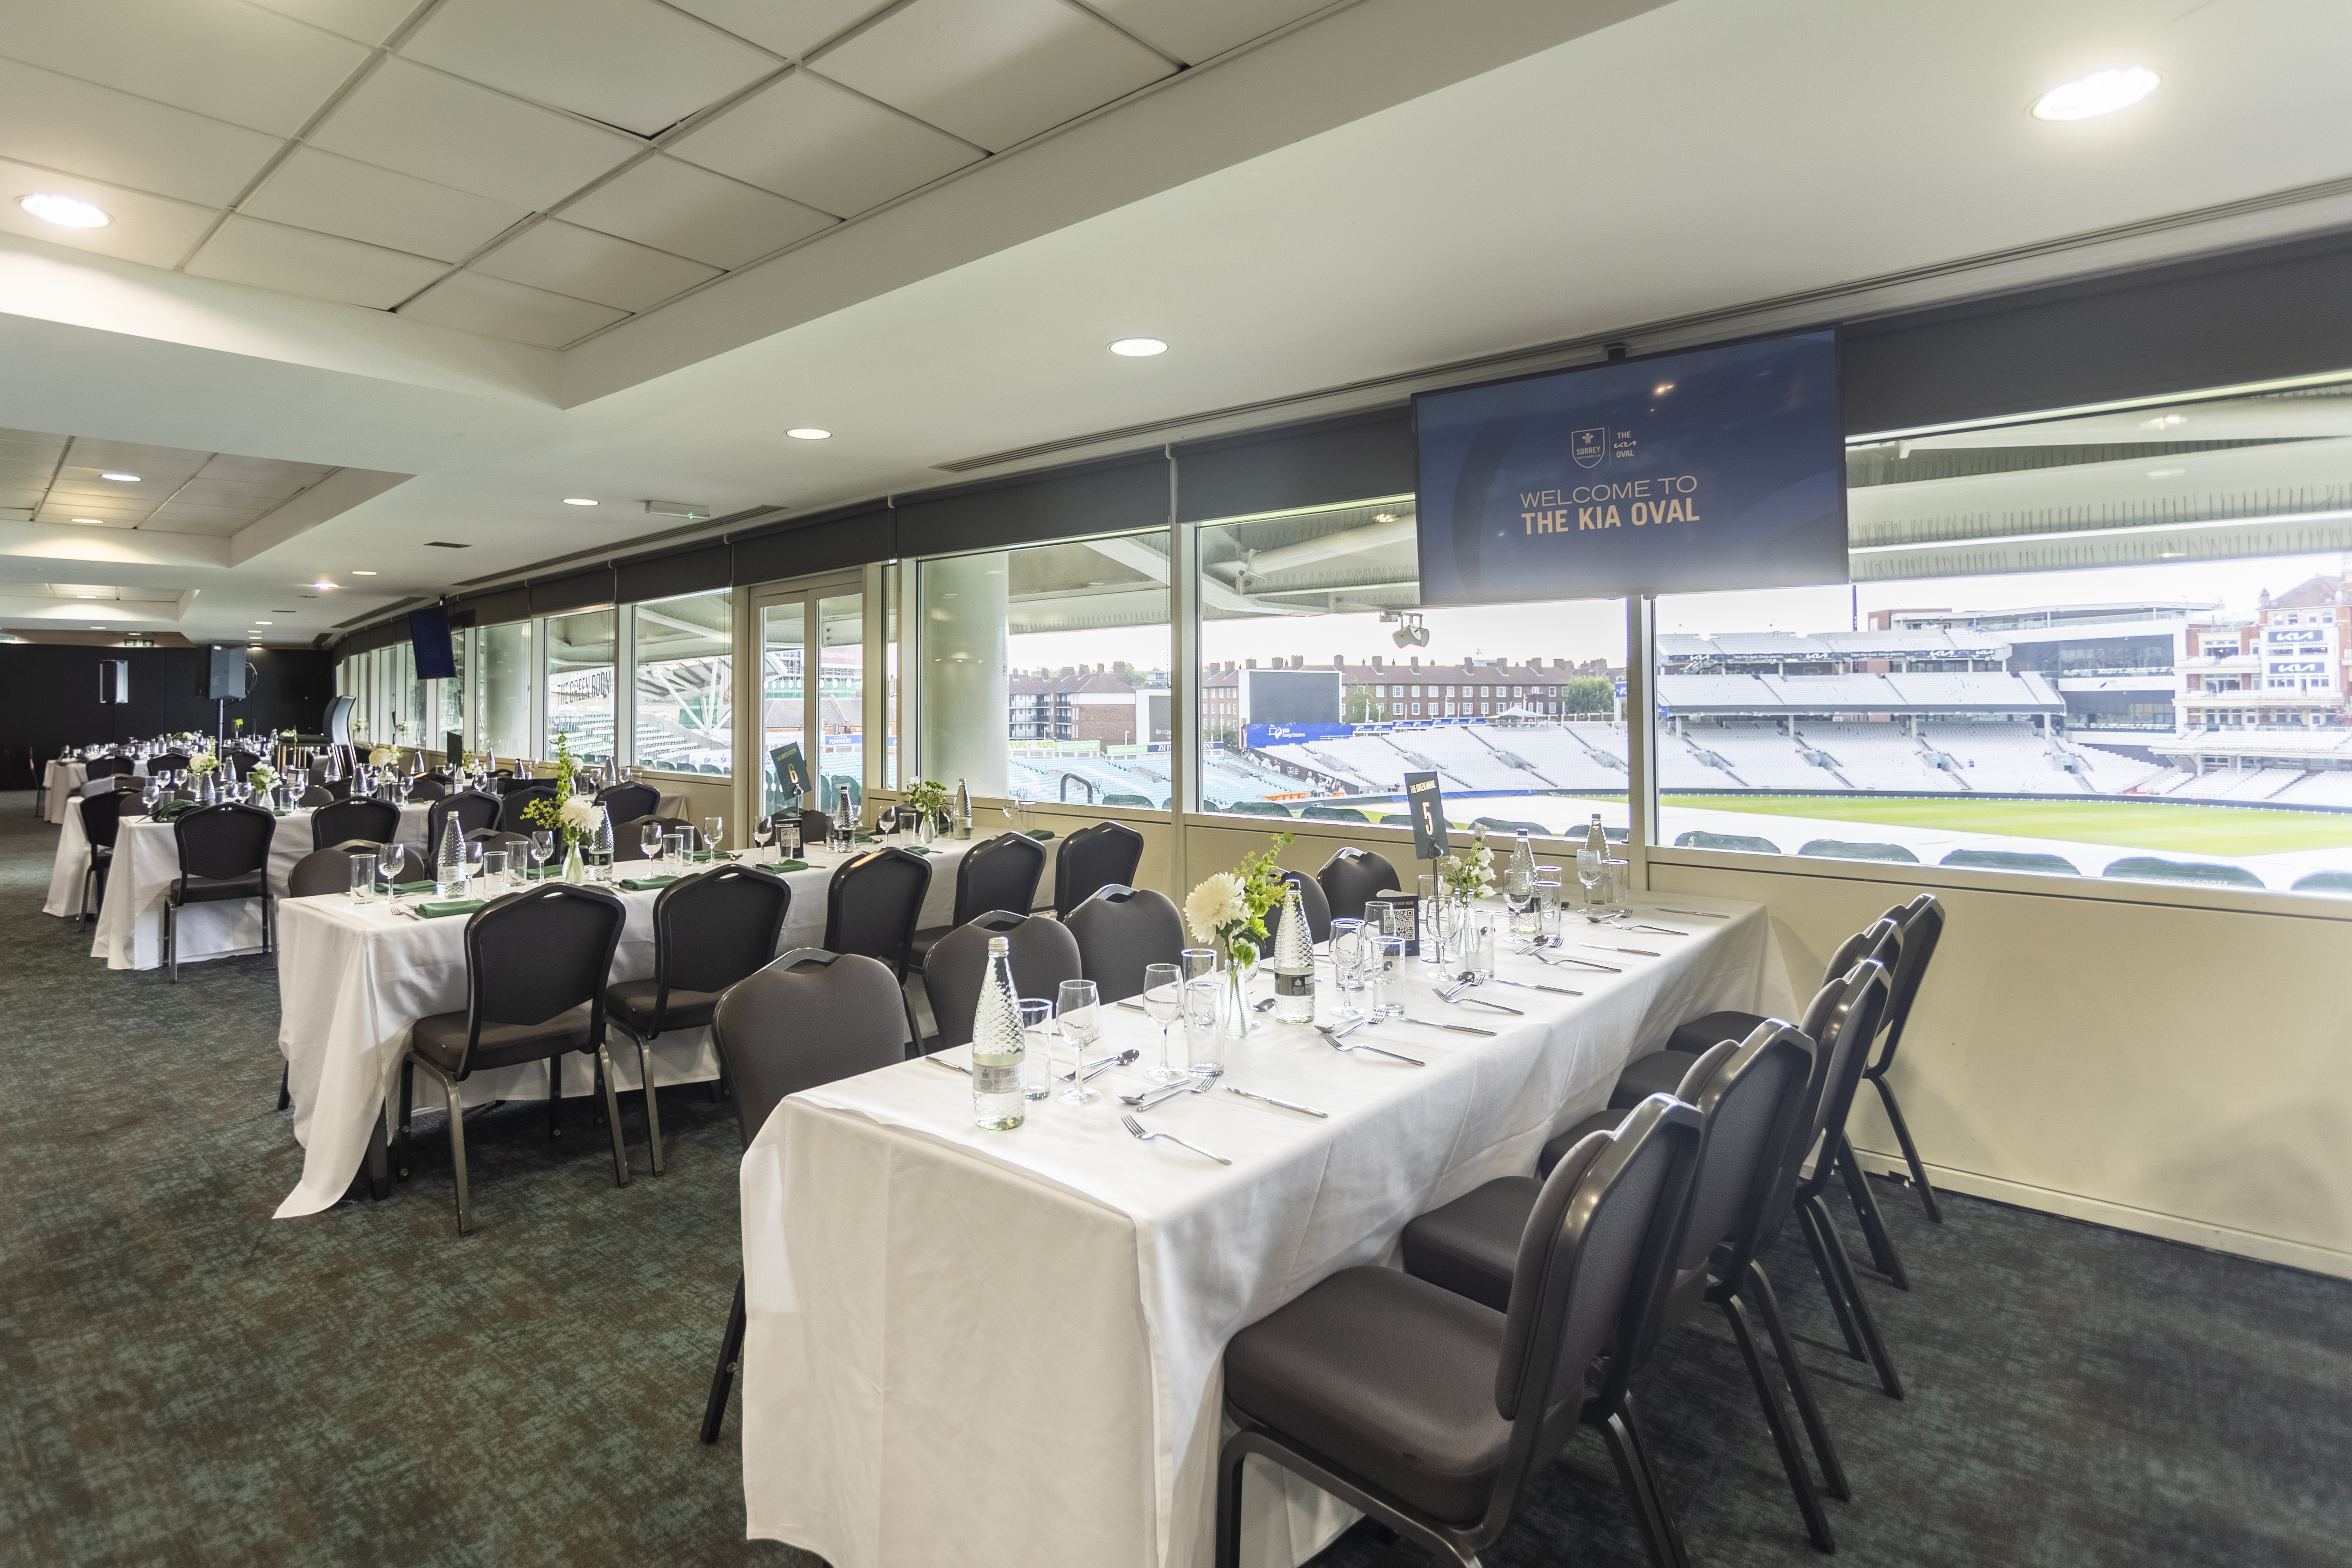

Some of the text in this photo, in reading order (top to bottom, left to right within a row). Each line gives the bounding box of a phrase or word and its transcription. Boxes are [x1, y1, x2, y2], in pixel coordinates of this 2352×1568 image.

[1617, 431, 1631, 439] THE
[1576, 446, 1601, 456] SURREY
[1616, 450, 1634, 458] OVAL
[1520, 475, 1697, 508] WELCOME TO
[1521, 498, 1700, 535] THE KIA OVAL
[2276, 632, 2314, 641] KIA
[2278, 663, 2315, 672] KIA
[558, 682, 569, 706] THE
[570, 676, 590, 703] GREEN
[787, 763, 799, 784] 6
[1416, 782, 1427, 793] GREEN
[1422, 802, 1433, 835] 5
